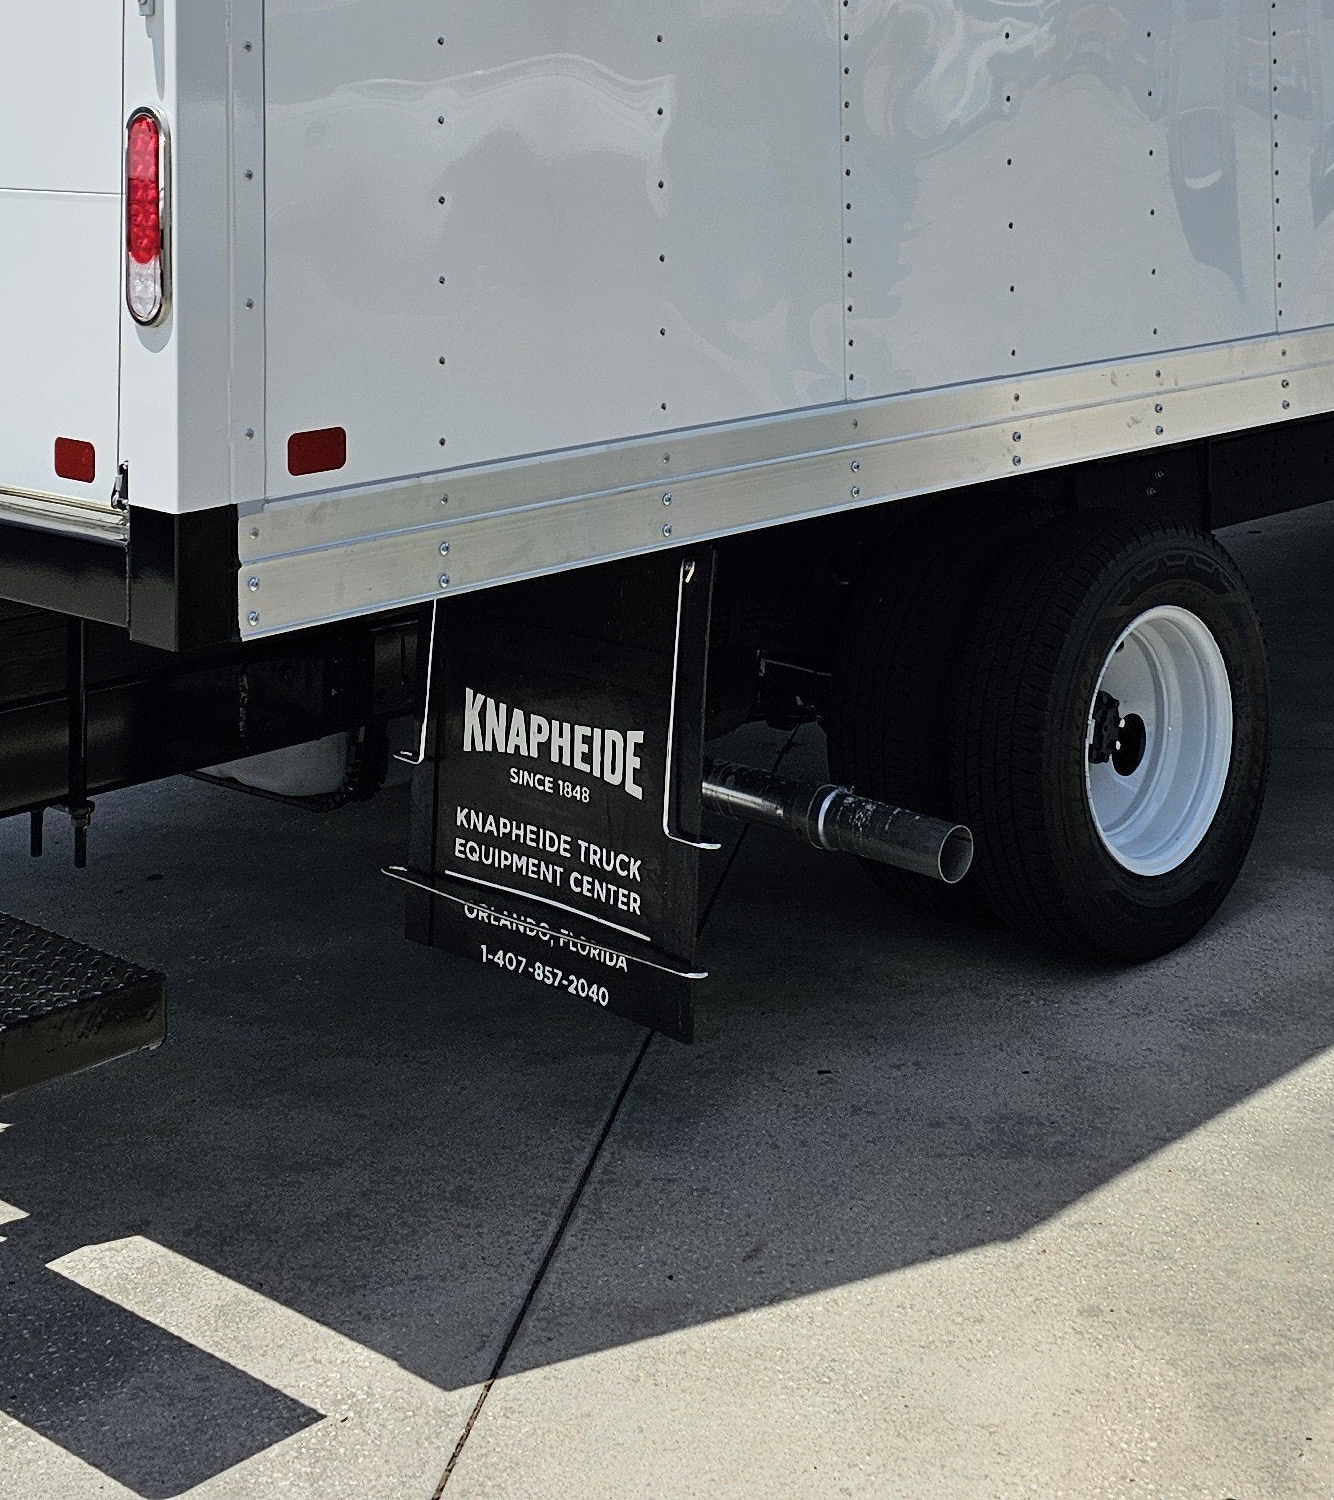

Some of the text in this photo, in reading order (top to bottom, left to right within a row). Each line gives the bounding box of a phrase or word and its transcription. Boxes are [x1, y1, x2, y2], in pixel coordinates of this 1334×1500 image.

[463, 687, 644, 801] KNAPHEIDE
[509, 767, 591, 804] SINCE 1848
[454, 837, 642, 916] EQUIPMENT CENTER
[455, 805, 643, 883] KNAPHEIDE TRUCK
[480, 944, 610, 1007] 1-407-857-2040
[559, 928, 629, 973] FLORIDA
